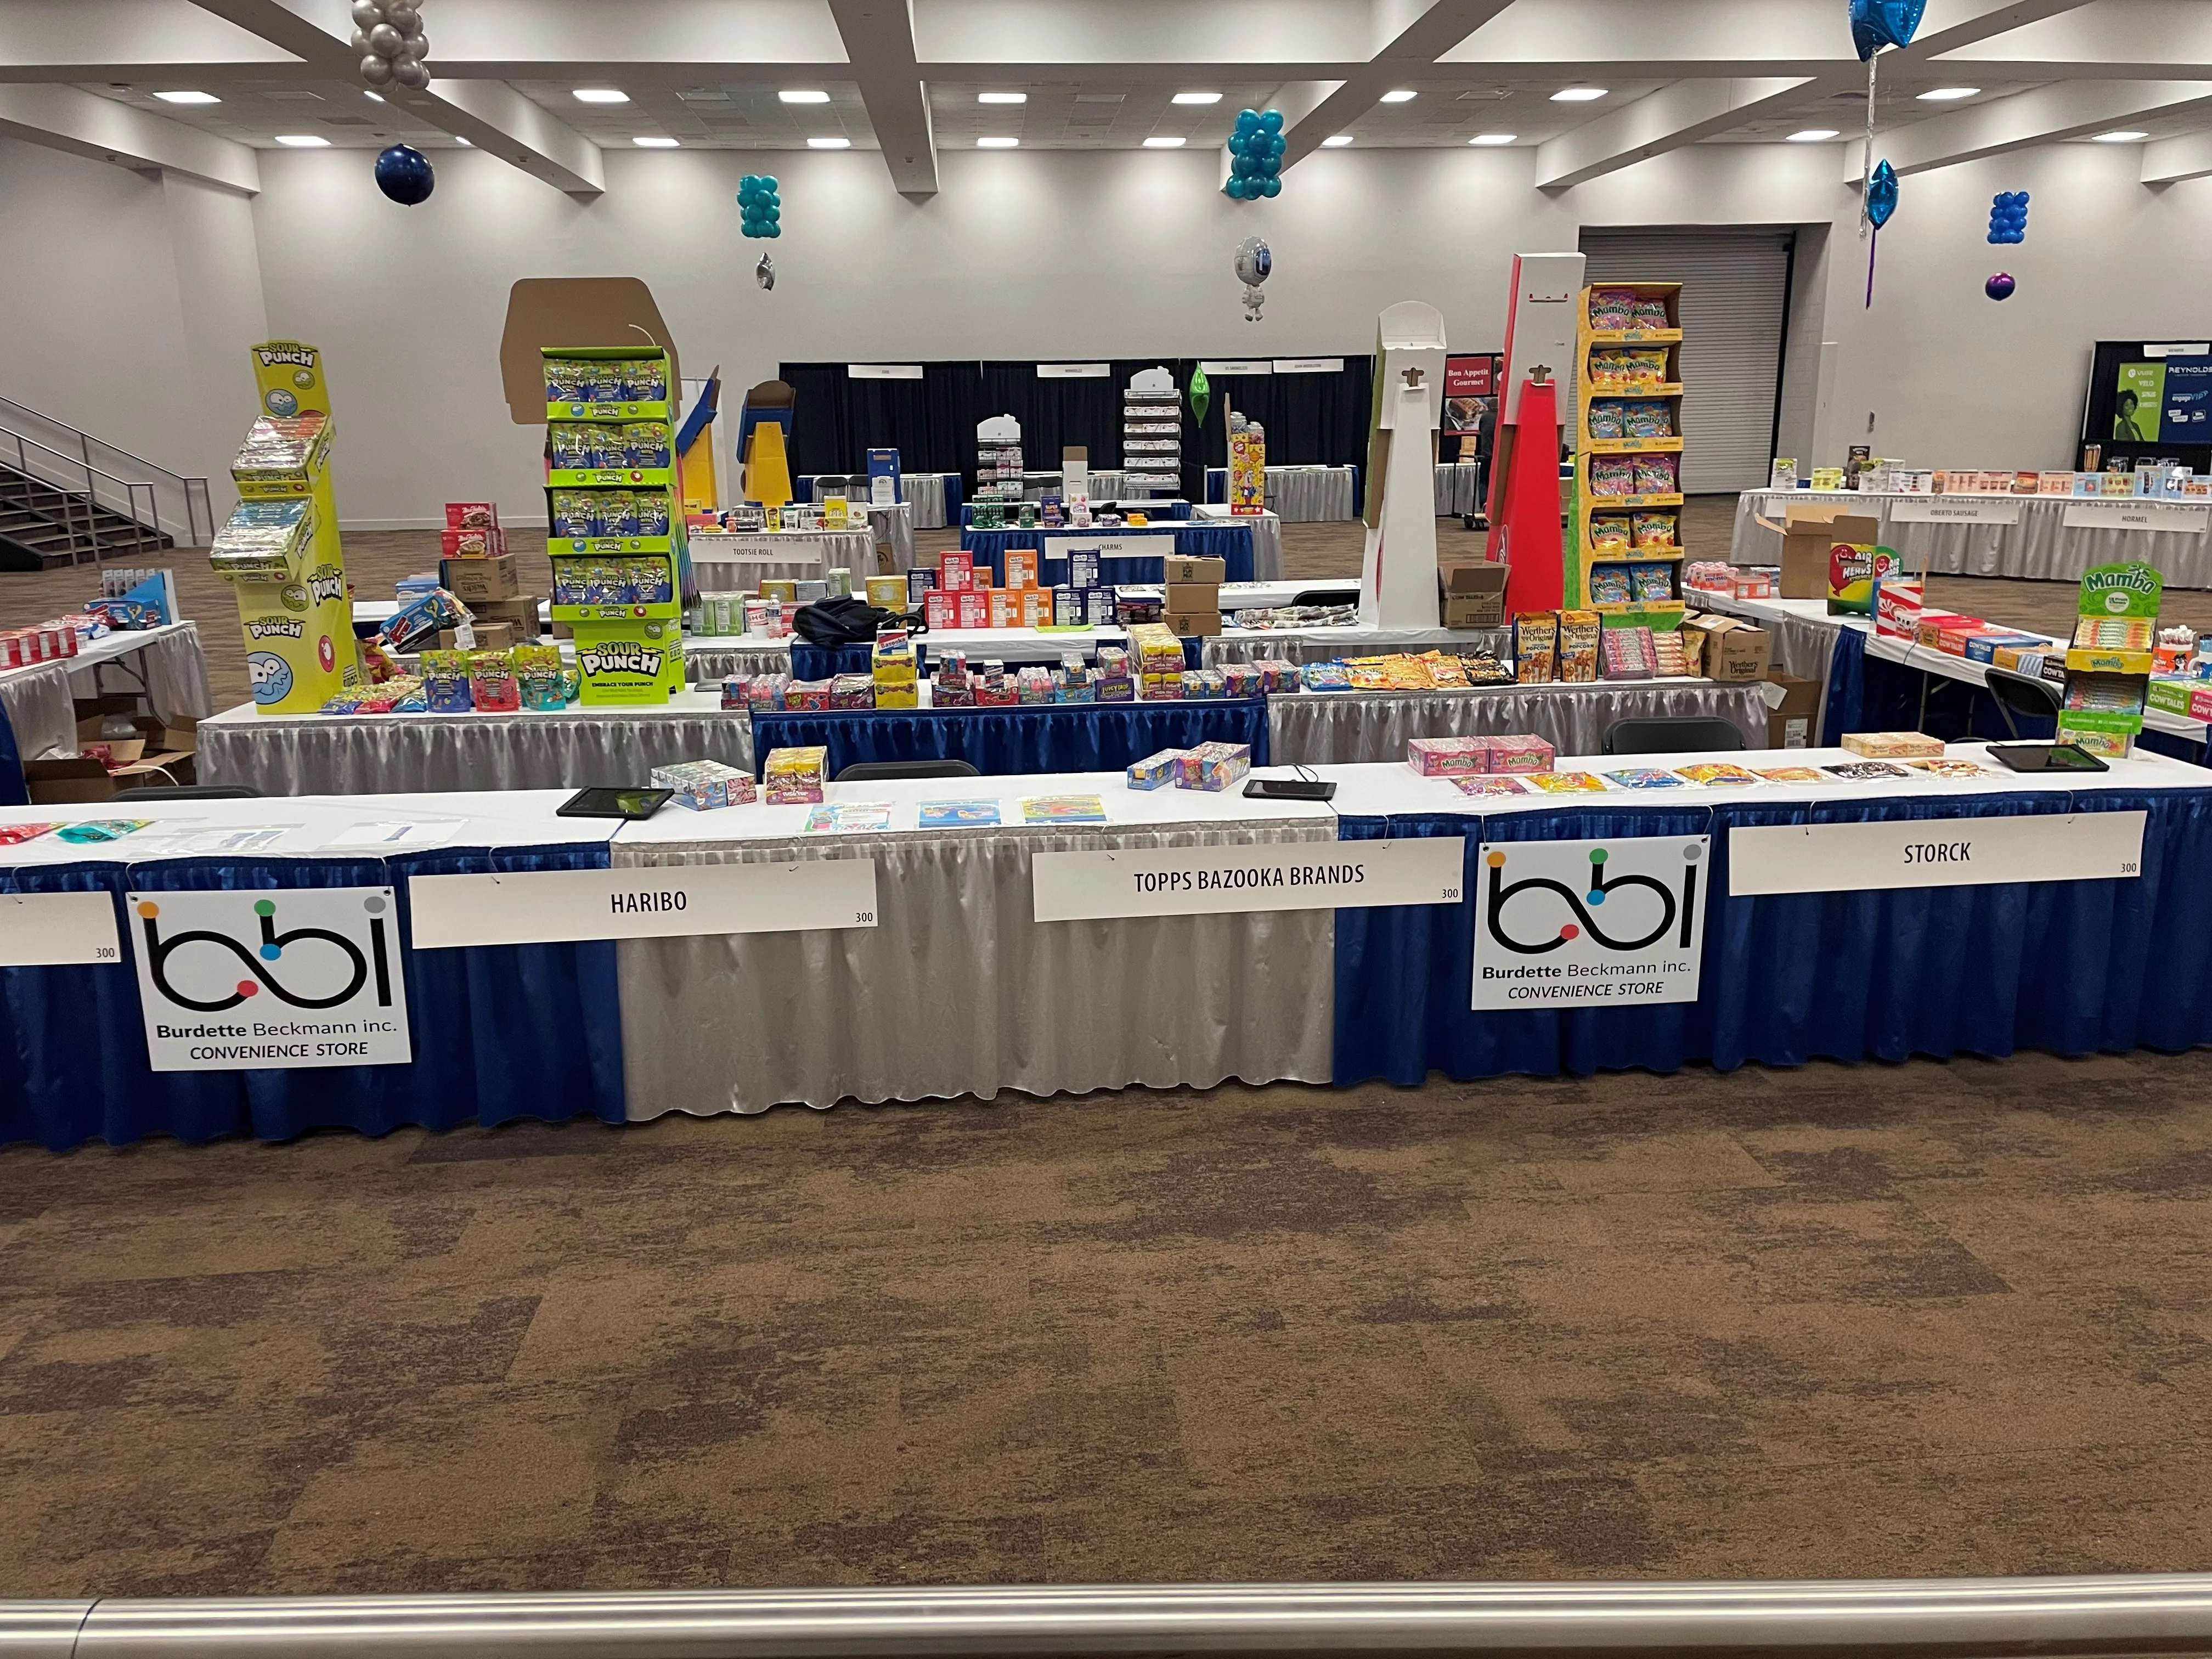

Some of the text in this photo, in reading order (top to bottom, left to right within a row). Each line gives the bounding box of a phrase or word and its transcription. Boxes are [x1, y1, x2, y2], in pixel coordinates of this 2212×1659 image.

[1593, 306, 1629, 317] Mamba
[1632, 307, 1665, 317] Mamba
[268, 342, 300, 353] SOUR
[259, 351, 314, 368] PUNCH
[1626, 361, 1660, 371] Mamba
[1463, 369, 1488, 377] Appetit
[627, 379, 659, 387] PUNCH
[592, 408, 619, 417] PUNCH
[1589, 414, 1621, 425] Mamba
[1627, 415, 1660, 425] Mamba
[560, 444, 590, 453] PUNCH
[631, 444, 663, 452] PUNCH
[595, 475, 623, 483] PUNCH
[1596, 471, 1630, 481] Mamba
[561, 512, 594, 521] PUNCH
[602, 511, 630, 520] PUNCH
[638, 512, 664, 520] UNCH
[1595, 526, 1628, 537] Mamba
[1638, 524, 1672, 535] Mamba
[595, 543, 622, 551] PUNCH
[1855, 551, 1872, 563] AIR
[230, 562, 272, 570] PUNCH
[1888, 558, 1900, 569] AIR
[317, 563, 334, 581] SOUR
[594, 579, 627, 588] PUNCH
[632, 577, 663, 586] PUNCH
[1594, 581, 1627, 591] Mamba
[1639, 579, 1669, 589] Mamba
[2085, 572, 2156, 595] Mamba
[311, 577, 343, 607] PUNCH
[600, 610, 627, 618] PUNCH
[258, 616, 289, 625] SOUR
[249, 624, 302, 640] PUNCH
[1520, 627, 1555, 635] Werther's
[1563, 625, 1599, 633] Werther's
[1571, 633, 1598, 641] Original
[881, 637, 906, 649] Bazooka
[596, 641, 642, 656] SOUR
[581, 654, 661, 678] PUNCH
[2091, 659, 2124, 669] Mamba
[428, 672, 460, 681] PUNCH
[475, 671, 510, 680] PUNCH
[523, 671, 557, 680] PUNCH
[1102, 685, 1117, 693] JUICY
[2075, 737, 2109, 748] Mamba
[1442, 758, 1472, 769] Mamba
[1508, 756, 1538, 766] Mamba
[1904, 842, 1971, 864] STORCK
[2121, 863, 2137, 872] 300
[1134, 864, 1364, 892] TOPPS BAZOOKA BRANDS
[1442, 889, 1458, 898] 300
[611, 891, 687, 913] HARIBO
[1487, 843, 1702, 955] bbi
[856, 913, 873, 922] 300
[96, 947, 115, 958] 300
[137, 896, 392, 1013] bbi
[1482, 961, 1690, 979] Burdette Beckmann inc.
[1508, 981, 1664, 999] CONVENIENCE STORE
[157, 1020, 397, 1038] Burdette Beckmann inc.
[190, 1042, 368, 1059] CONVENIENCE STORE
